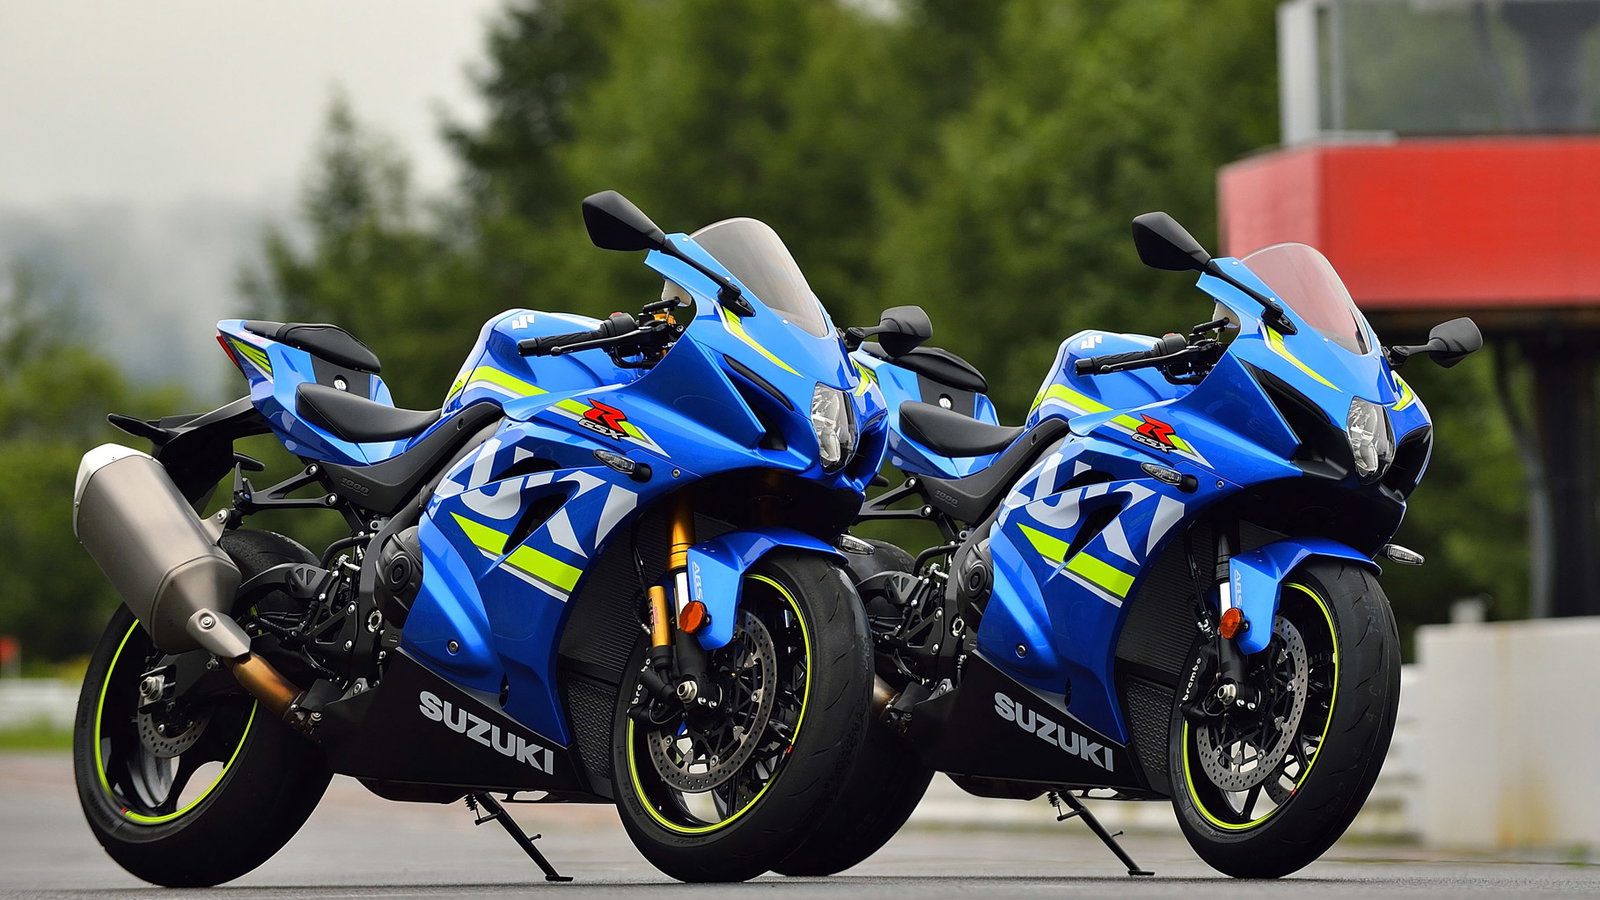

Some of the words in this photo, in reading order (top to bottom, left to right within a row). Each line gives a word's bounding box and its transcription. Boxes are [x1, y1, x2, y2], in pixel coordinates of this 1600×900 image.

[579, 418, 624, 440] GSX
[1132, 433, 1173, 453] GSX
[692, 561, 703, 601] ABS
[1234, 569, 1243, 607] ABS
[1182, 657, 1201, 701] brembo
[419, 690, 554, 775] SUZUKI
[994, 692, 1114, 772] SUZUKI
